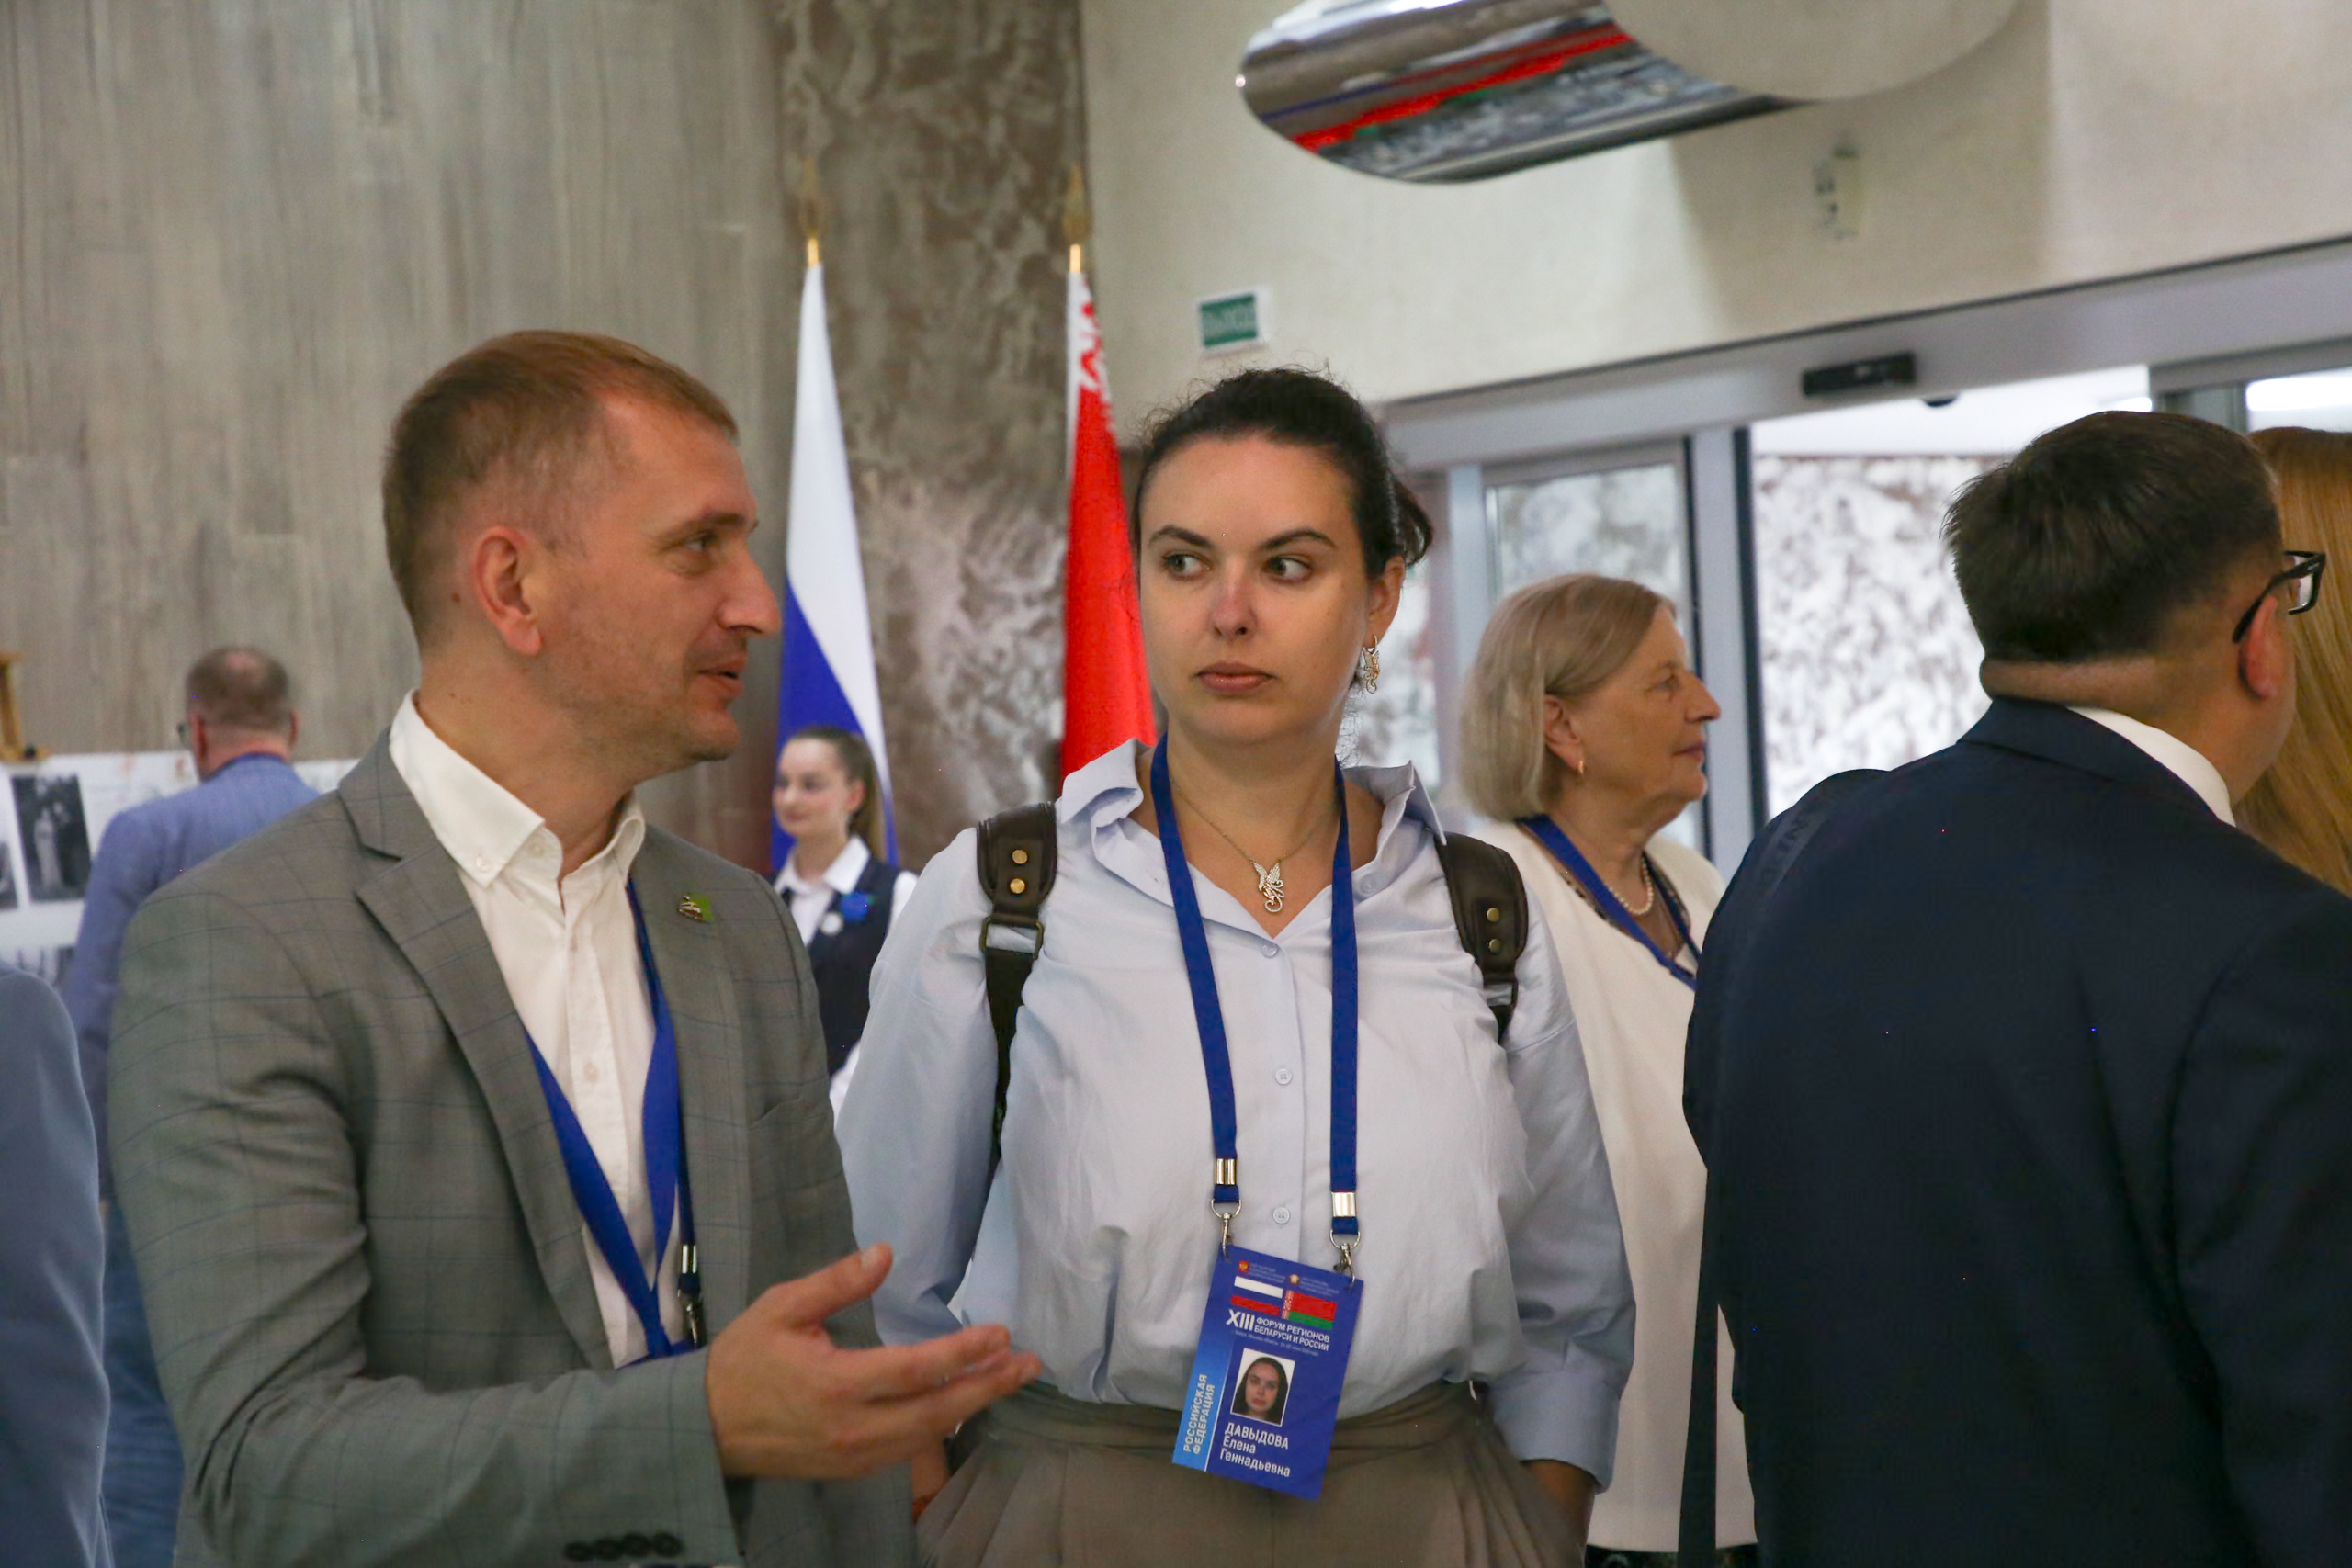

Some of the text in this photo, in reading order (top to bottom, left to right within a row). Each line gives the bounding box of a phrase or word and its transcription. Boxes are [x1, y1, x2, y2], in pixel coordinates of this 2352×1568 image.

[1226, 1308, 1255, 1331] XIII
[1256, 1316, 1286, 1331] ФОРУМ
[1286, 1325, 1330, 1343] РЕГИОНОВ
[1254, 1325, 1293, 1341] БЕЛАРУСИ
[1292, 1335, 1299, 1343] И
[1298, 1337, 1329, 1351] РОССИИ
[1183, 1373, 1207, 1453] РОССИЙСКАЯ
[1193, 1383, 1216, 1455] ФЕДЕРАЦИЯ
[1223, 1435, 1256, 1454] Елена
[1224, 1422, 1289, 1450] ДАВЫДОВА
[1219, 1448, 1291, 1478] Геннадьевна
